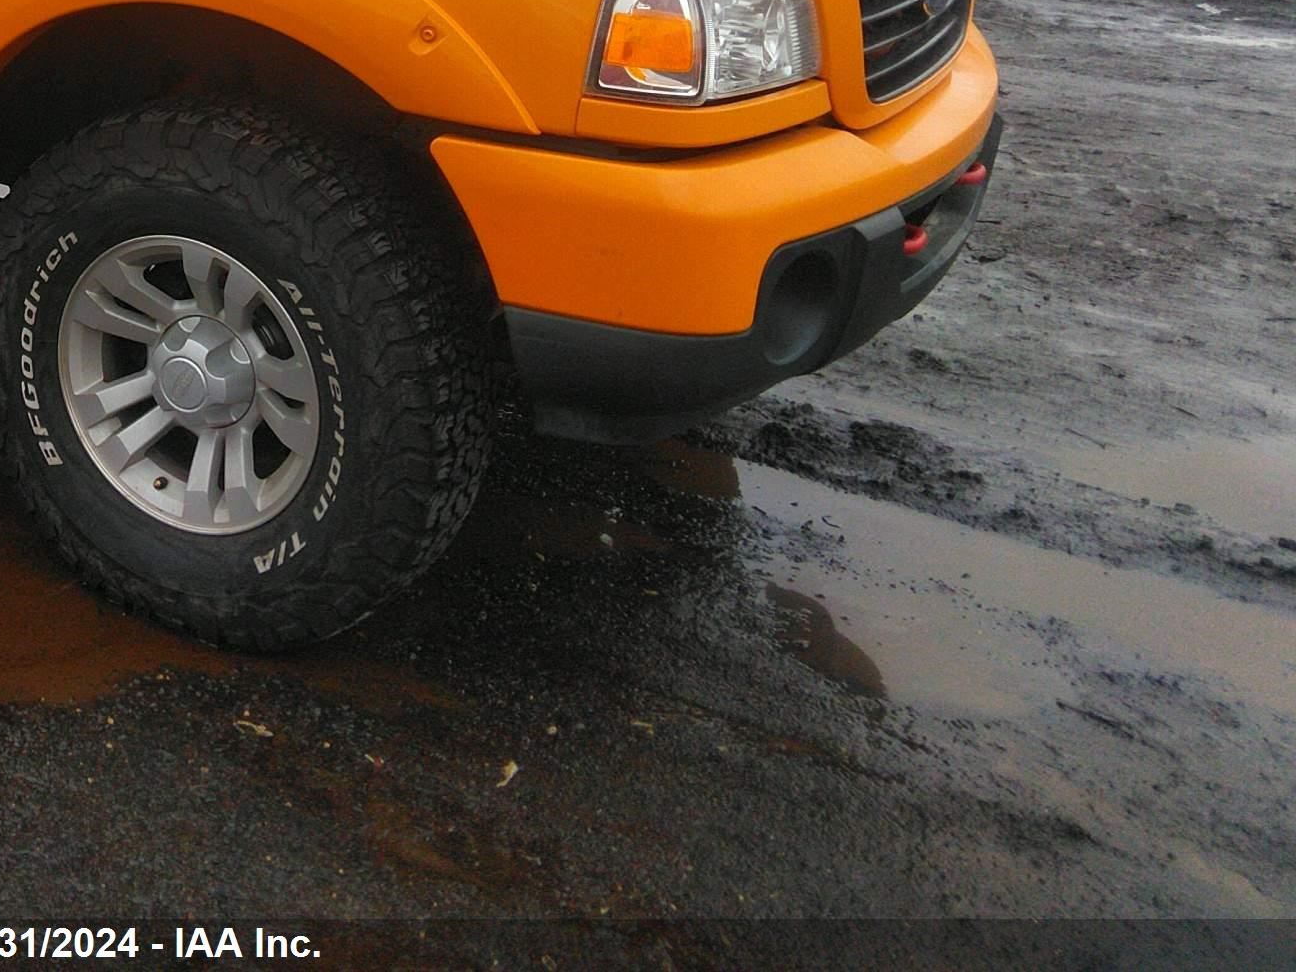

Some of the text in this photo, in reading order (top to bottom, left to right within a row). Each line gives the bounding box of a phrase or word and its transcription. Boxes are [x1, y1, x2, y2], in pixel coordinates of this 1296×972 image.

[20, 230, 79, 467] BFGoodrich
[253, 278, 345, 574] All-Terrain T/A
